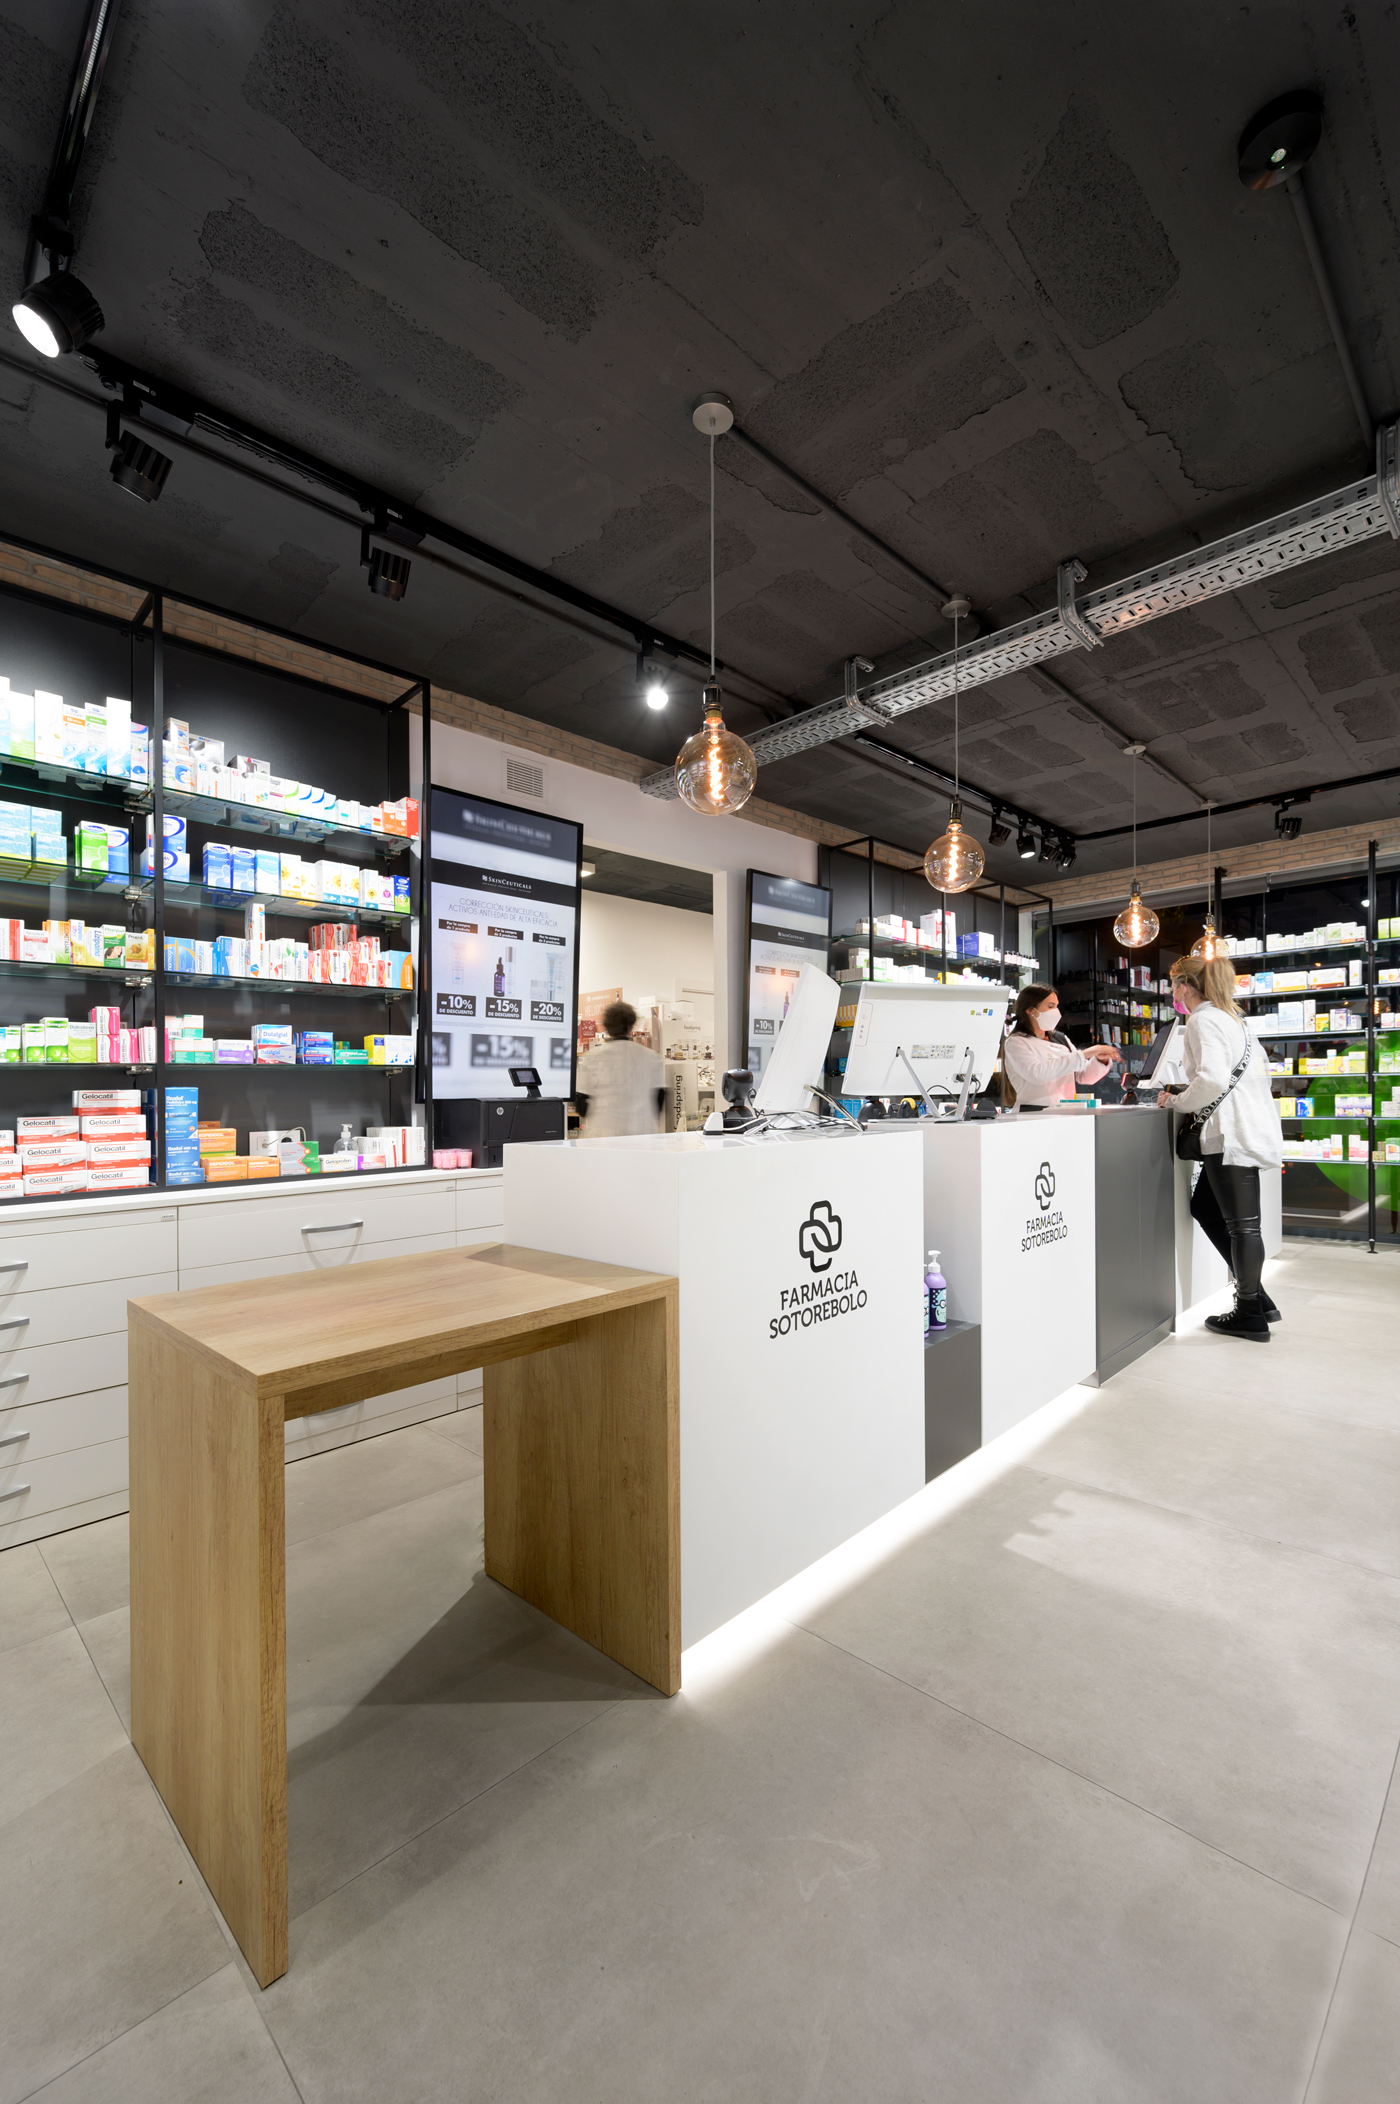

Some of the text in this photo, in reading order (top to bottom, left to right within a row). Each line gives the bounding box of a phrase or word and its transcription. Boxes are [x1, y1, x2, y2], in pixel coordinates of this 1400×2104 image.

[448, 904, 478, 915] ACTIVOS
[532, 918, 558, 927] EFICACIA
[460, 898, 504, 911] CORRECCIÓN
[93, 930, 102, 956] Lizipaina
[441, 996, 473, 1010] -10%
[490, 1000, 519, 1013] -15%
[534, 1003, 562, 1016] -20%
[756, 1020, 772, 1030] -10%
[674, 1075, 683, 1130] odspring
[1026, 1210, 1064, 1234] FARMACIA
[1021, 1225, 1068, 1252] SOTOREBOLO
[780, 1270, 858, 1310] FARMACIA
[769, 1290, 868, 1339] SOTOREBOLO
